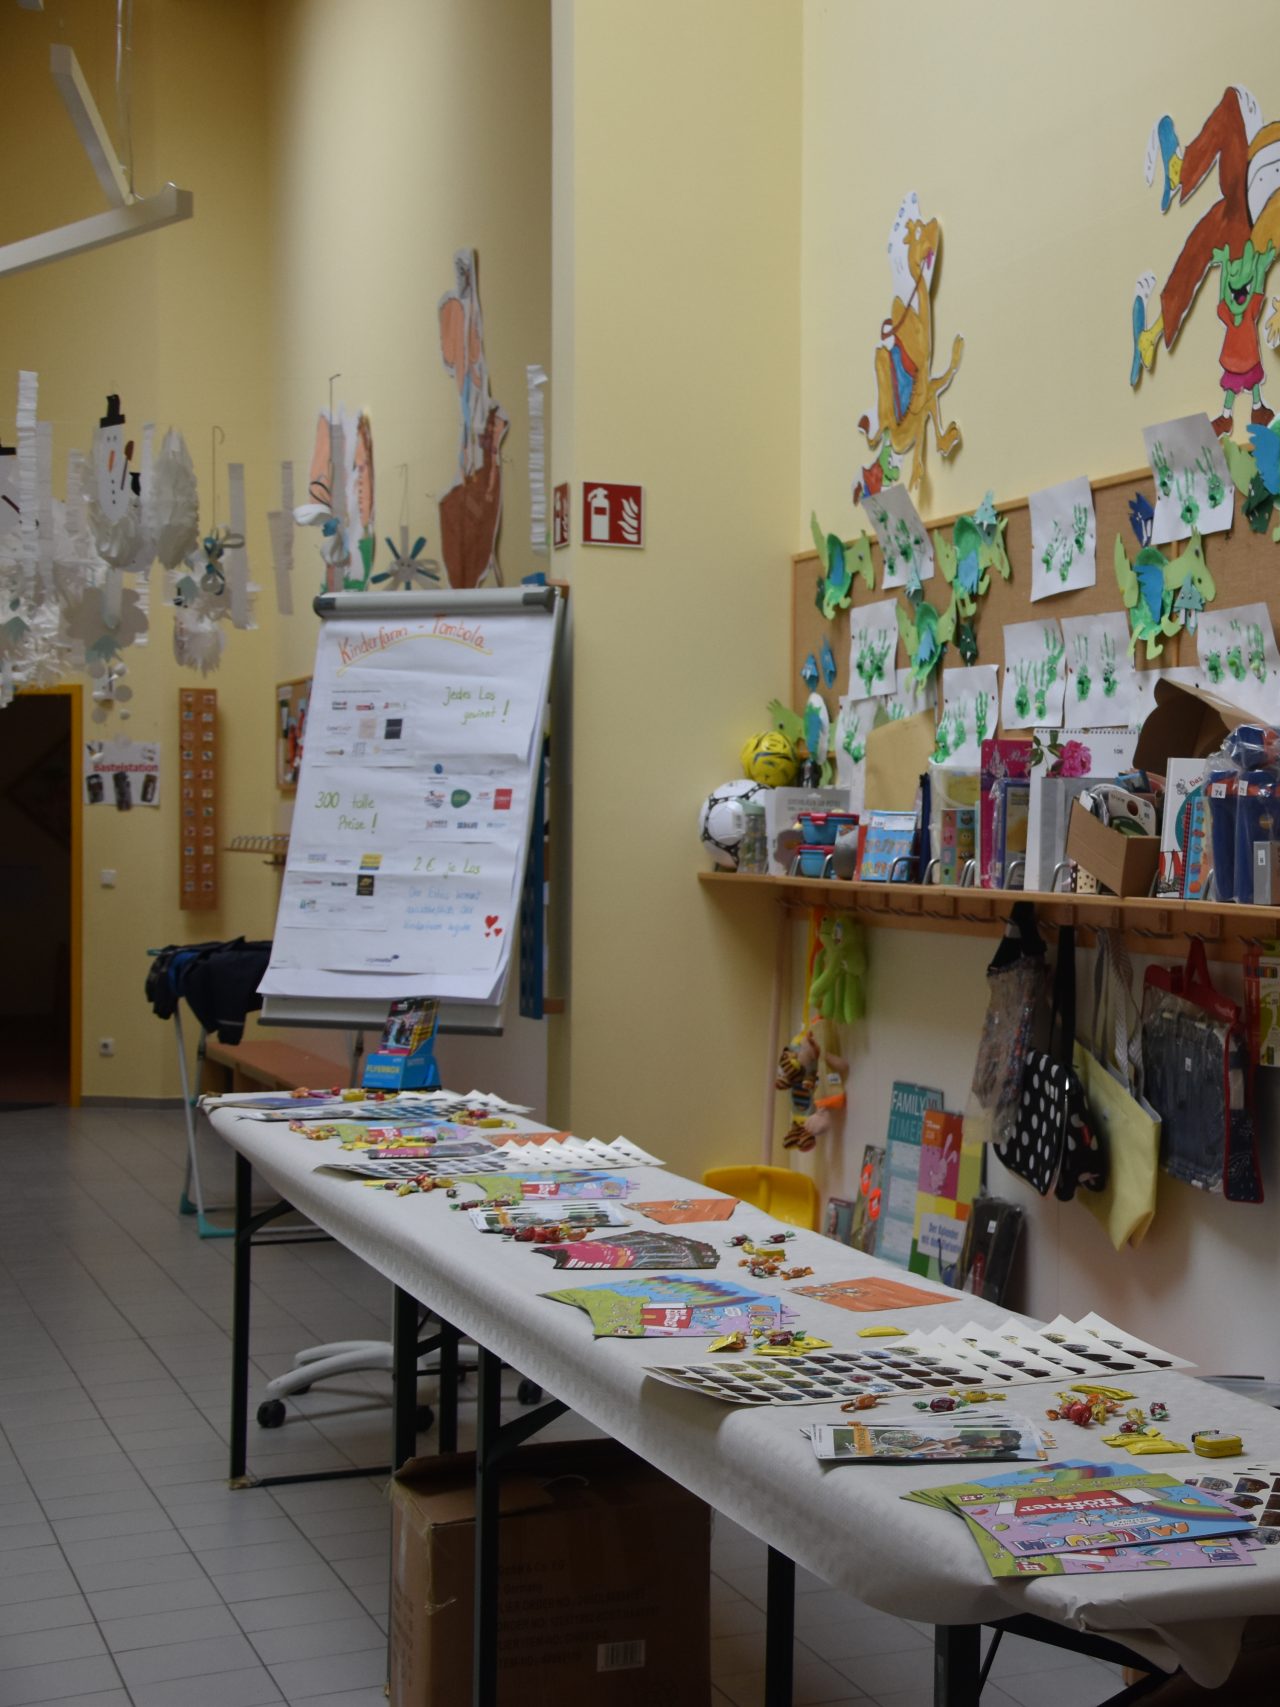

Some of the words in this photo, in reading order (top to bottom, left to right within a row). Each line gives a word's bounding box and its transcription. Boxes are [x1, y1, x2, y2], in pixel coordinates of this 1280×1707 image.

[337, 625, 408, 665] Kinderfarm
[433, 614, 486, 649] Tombola
[442, 686, 472, 706] Jedes
[478, 686, 496, 702] Los
[314, 790, 340, 810] 300
[351, 793, 376, 810] tolle
[1214, 789, 1223, 797] 74
[337, 814, 367, 832] Preise
[413, 855, 423, 872] 2
[425, 856, 437, 873] €
[464, 858, 482, 876] Los
[891, 1090, 927, 1116] FAMILY
[1019, 1496, 1124, 1513] Höffner
[1012, 1521, 1191, 1552] MALBUCH
